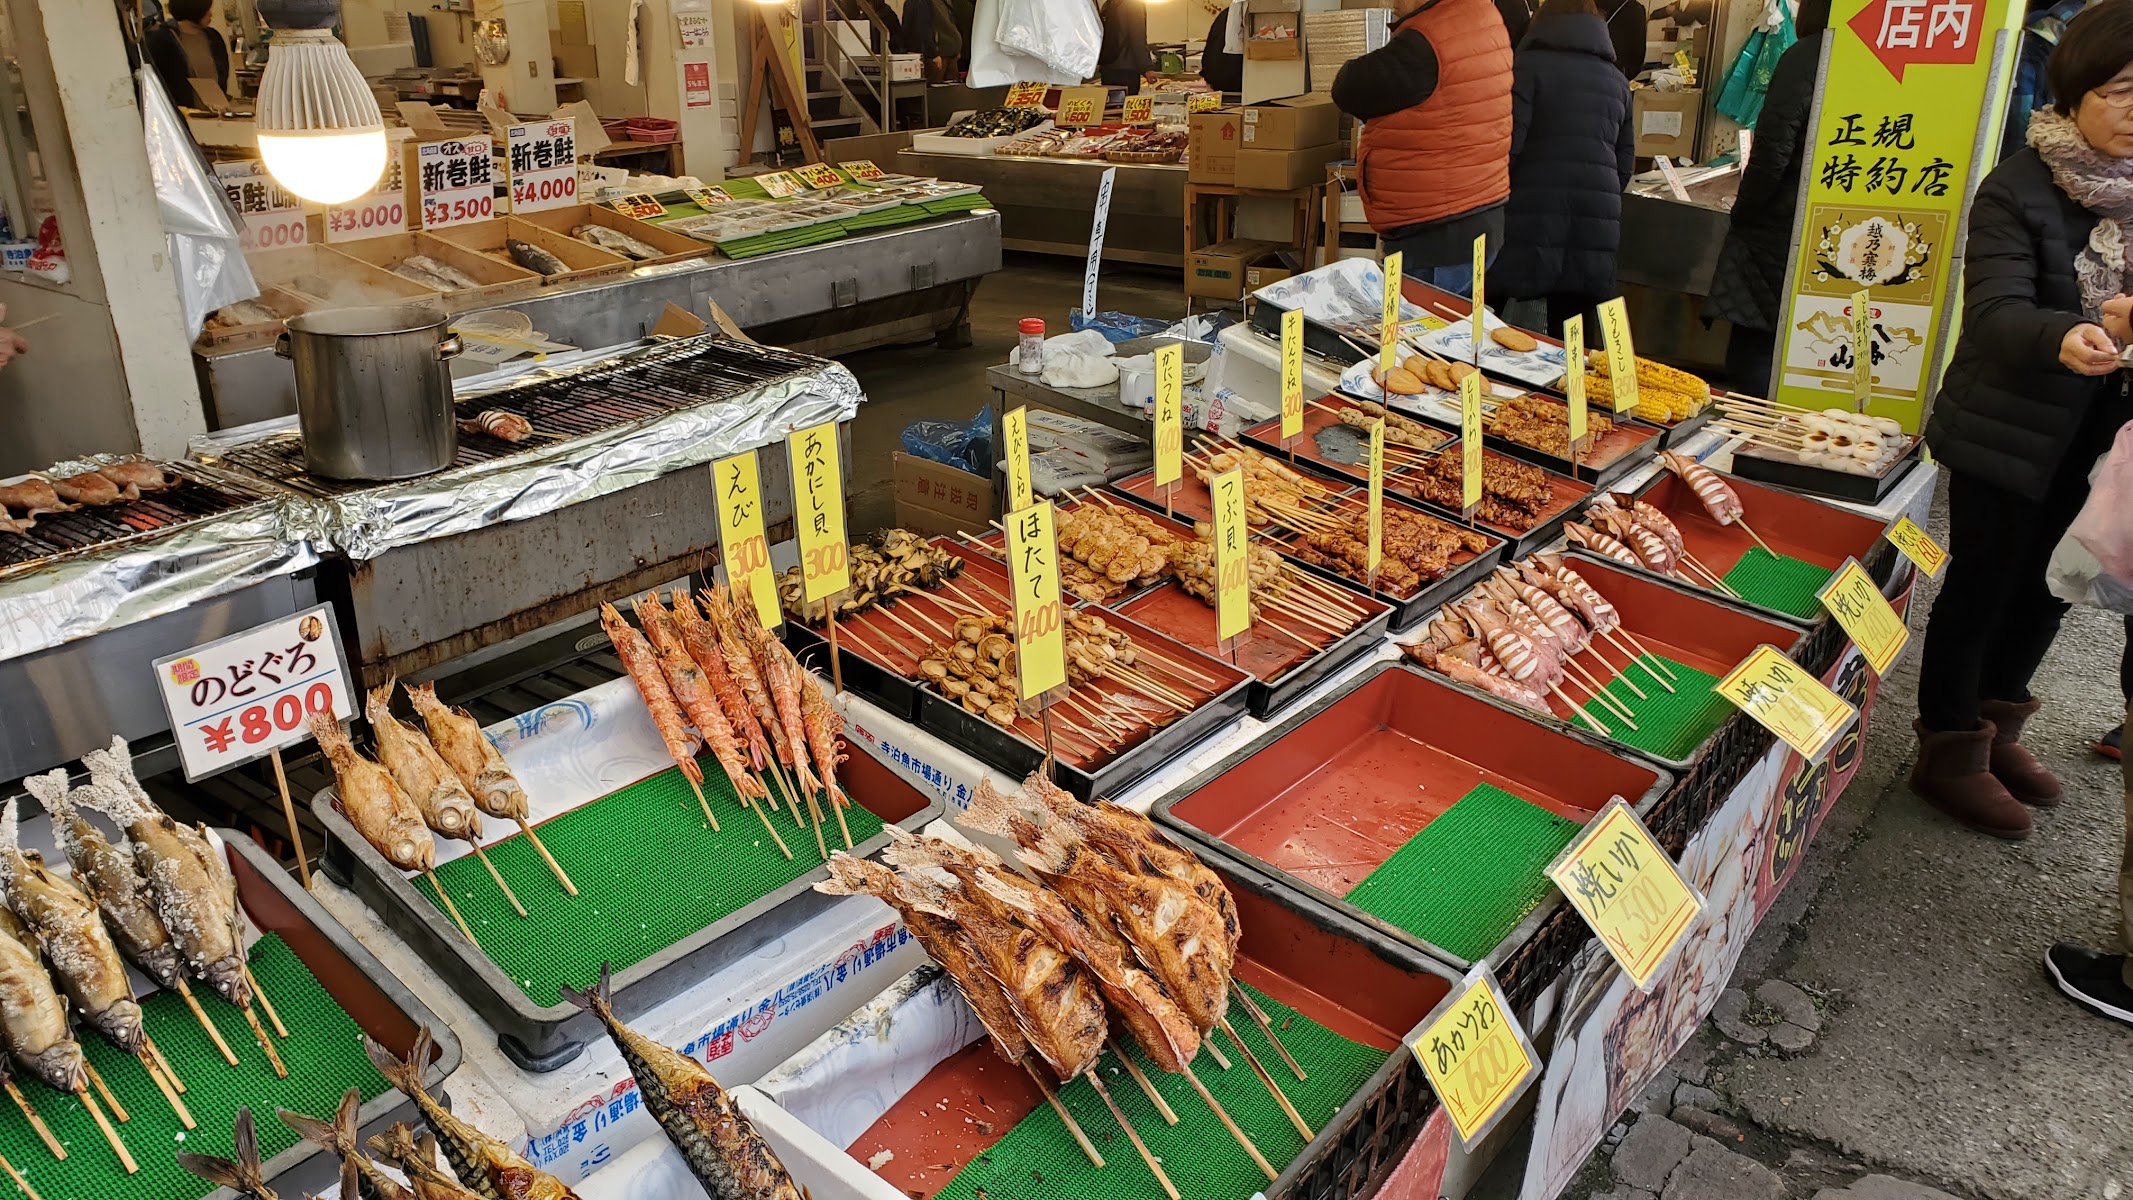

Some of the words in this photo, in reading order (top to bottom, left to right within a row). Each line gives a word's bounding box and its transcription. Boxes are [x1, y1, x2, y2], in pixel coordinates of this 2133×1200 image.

[1876, 0, 1973, 49] 店内
[442, 142, 462, 156] オス
[1828, 113, 1915, 150] 正規
[423, 154, 491, 192] 新巻鮭
[512, 137, 575, 173] 新巻鮭
[1820, 154, 1954, 196] 特約店
[425, 196, 492, 225] ¥3,500
[514, 177, 575, 205] ¥4,000
[330, 204, 403, 232] ¥3,000
[1858, 223, 1884, 281] 越乃寒梅
[1607, 305, 1626, 373] とうもろこし
[1161, 351, 1175, 424] かにつくね
[1283, 391, 1302, 419] 300
[1615, 373, 1637, 400] 350
[1157, 425, 1180, 456] 400
[728, 463, 754, 527] えび
[804, 432, 829, 538] あかにし貝
[1221, 481, 1238, 554] つぶ貝
[728, 534, 768, 579] 300
[805, 541, 846, 580] 300
[1020, 512, 1046, 599] ほたて
[1220, 556, 1247, 597] 400
[1020, 600, 1060, 646] 400
[191, 641, 316, 707] のどぐろ
[198, 682, 333, 754] ¥800
[880, 740, 952, 791] 寺泊魚市場通り
[1569, 831, 1640, 920] 焼いか
[1431, 994, 1495, 1075] あかうお
[1449, 1034, 1509, 1117] ¥600
[595, 1091, 644, 1132] 場通り
